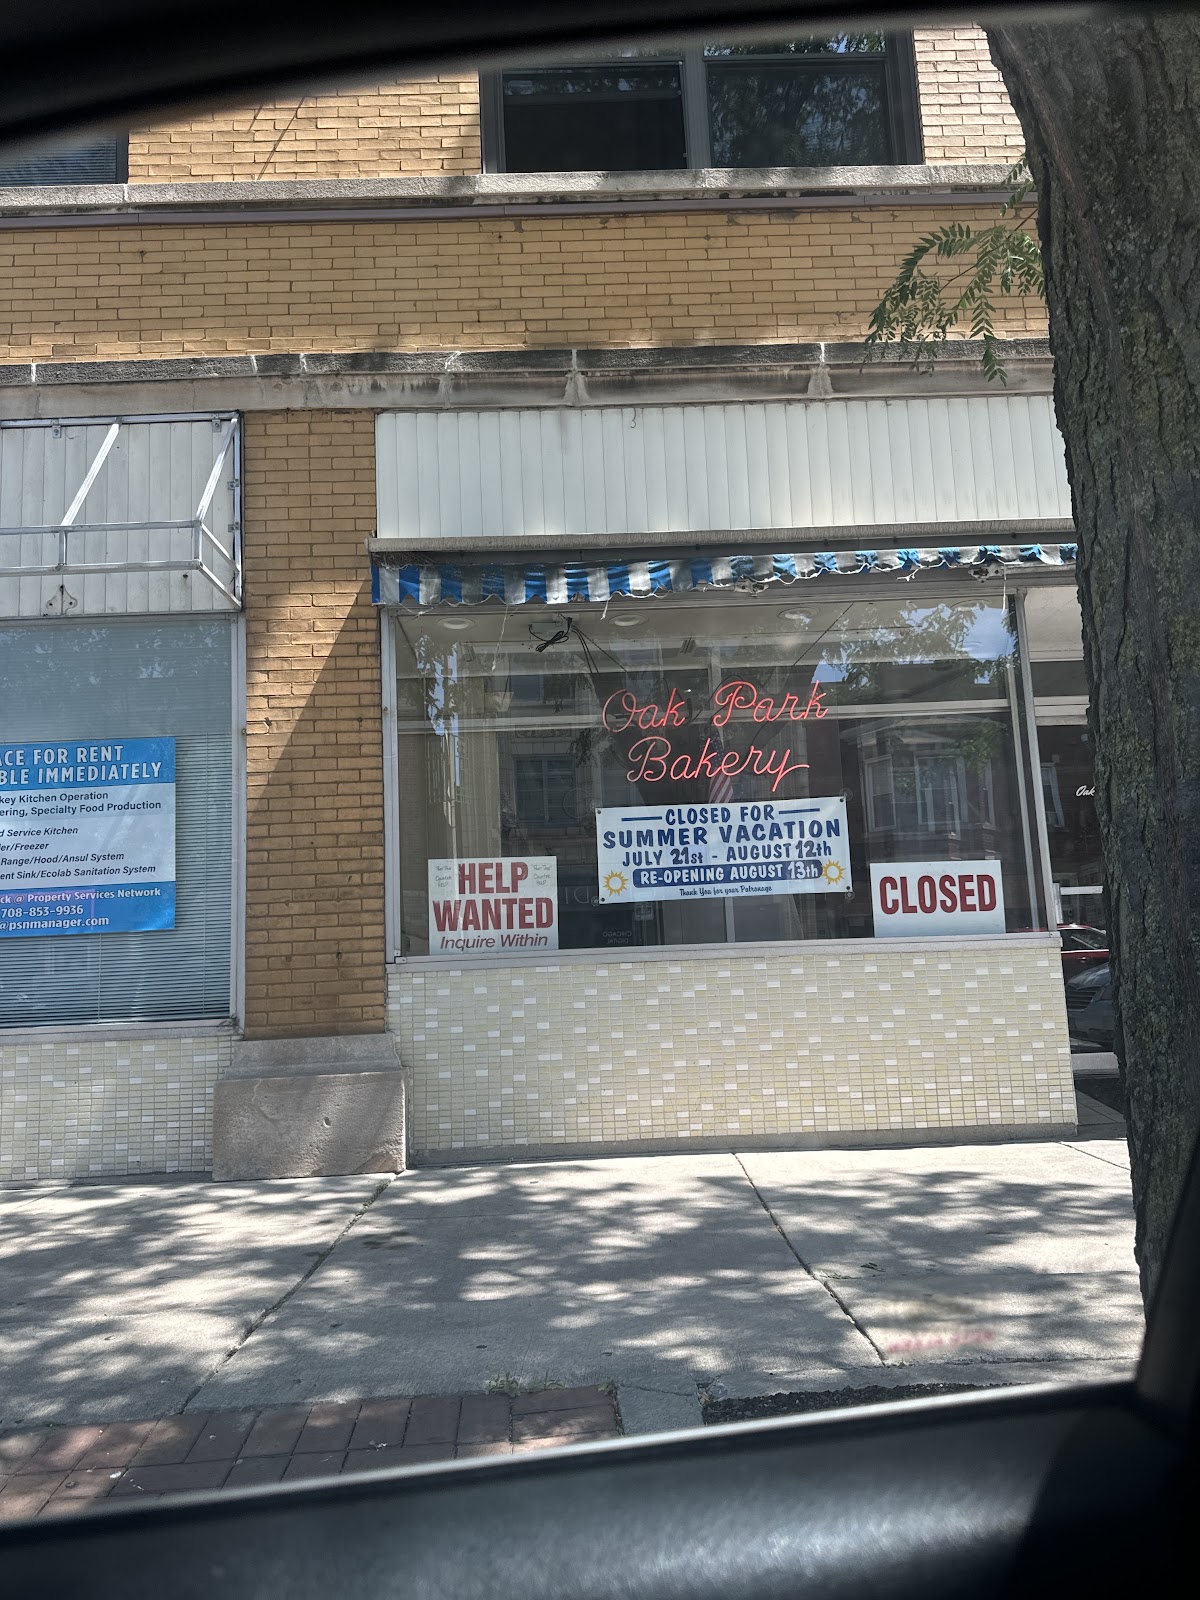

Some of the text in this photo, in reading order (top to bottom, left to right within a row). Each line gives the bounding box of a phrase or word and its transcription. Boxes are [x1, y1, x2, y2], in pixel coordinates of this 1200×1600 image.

[602, 680, 829, 732] Oak Park
[0, 745, 124, 766] CE FOR RENT
[626, 736, 810, 792] Bakery
[0, 762, 162, 786] BLE IMMEDIATELY
[19, 794, 57, 803] Kitchen
[59, 792, 109, 803] Operation
[1075, 784, 1096, 797] Oak
[31, 805, 77, 816] Specialty
[80, 803, 104, 812] Food
[107, 800, 161, 811] Production
[665, 804, 775, 825] CLOSED FOR
[7, 828, 42, 837] Service
[44, 827, 79, 836] Kitchen
[603, 819, 841, 849] SUMMER VACATION
[0, 843, 49, 852] er/Freezer
[622, 850, 663, 867] JULY
[670, 847, 704, 865] 21st
[726, 843, 792, 862] AUGUST
[795, 840, 832, 859] 12th
[1, 853, 125, 867] Range/Hood/Ansul System
[17, 868, 72, 879] Sink/Ecolab
[74, 867, 120, 877] Sanitation
[122, 865, 156, 875] System
[458, 862, 529, 894] HELP
[640, 861, 819, 885] RE-OPENING AUGUST 13th
[14, 894, 25, 905] @
[28, 892, 72, 903] Property
[74, 890, 115, 900] Services
[117, 887, 161, 898] Network
[679, 885, 772, 896] Thank You for your Patronage
[879, 874, 997, 915] CLOSED
[1, 904, 84, 919] 708-853-9936
[432, 897, 554, 932] WANTED
[440, 933, 548, 951] Inquire Within
